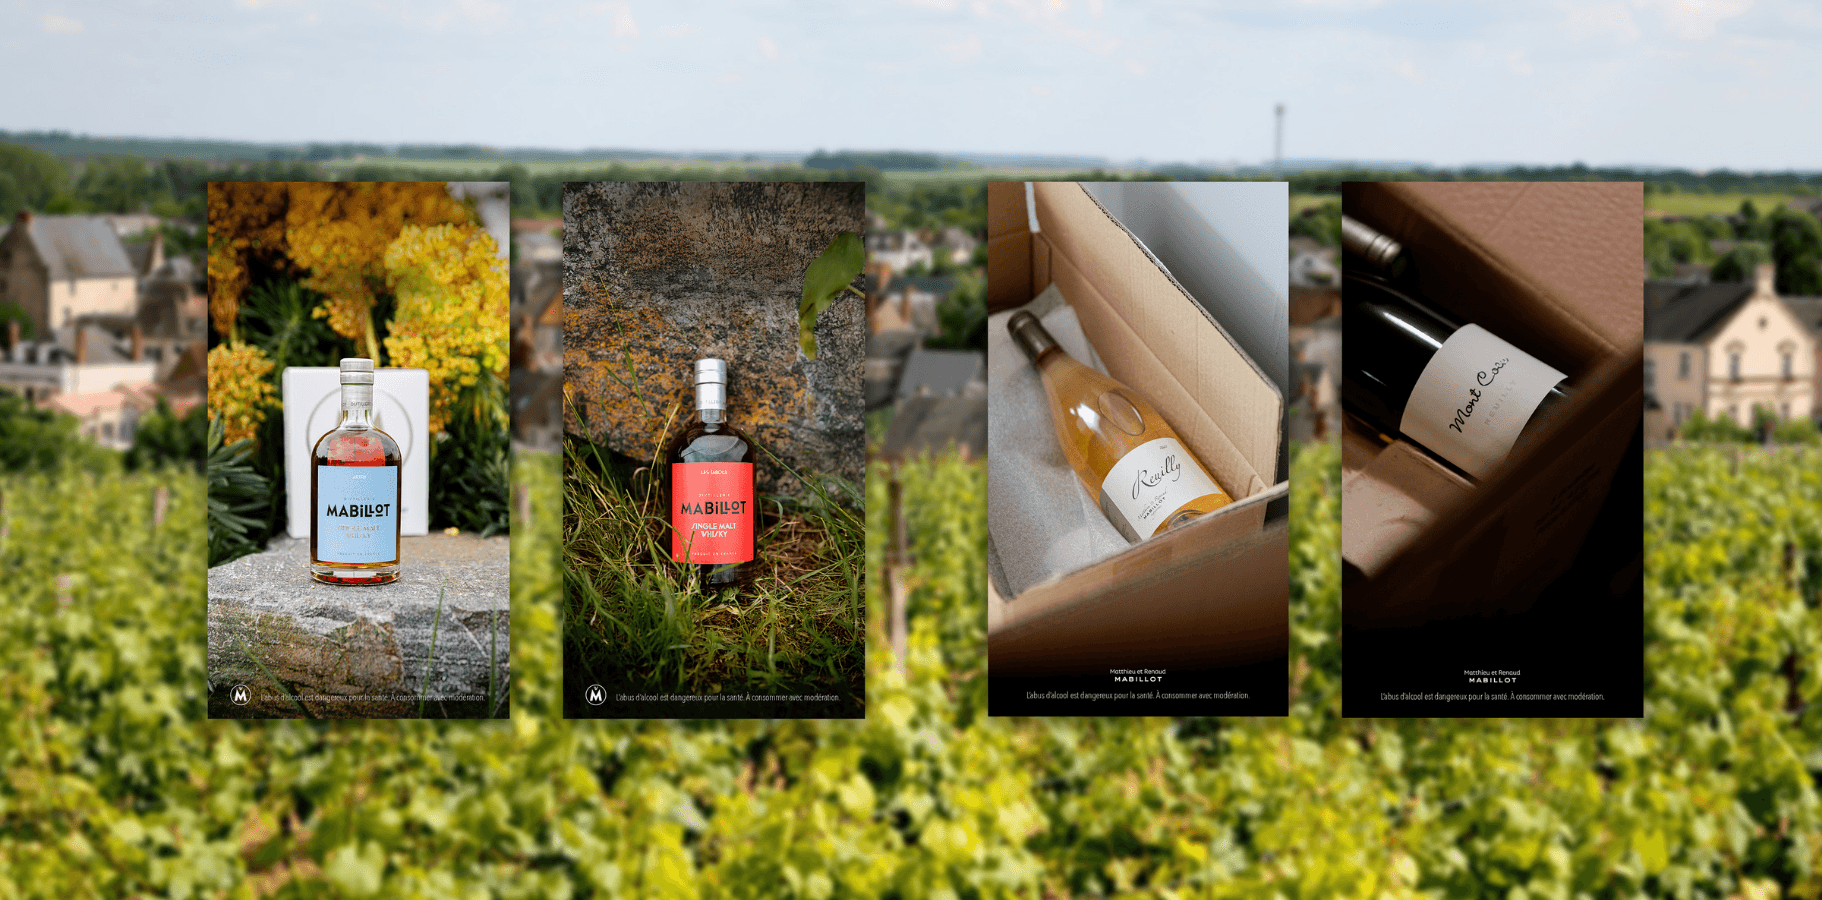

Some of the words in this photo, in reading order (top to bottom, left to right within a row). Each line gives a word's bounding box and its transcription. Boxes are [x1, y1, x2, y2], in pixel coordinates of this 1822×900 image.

[1449, 388, 1481, 433] Mont
[1132, 454, 1181, 500] Reuilly
[691, 522, 717, 530] SINGLE
[718, 522, 737, 530] MALT
[700, 530, 728, 538] WHISKY
